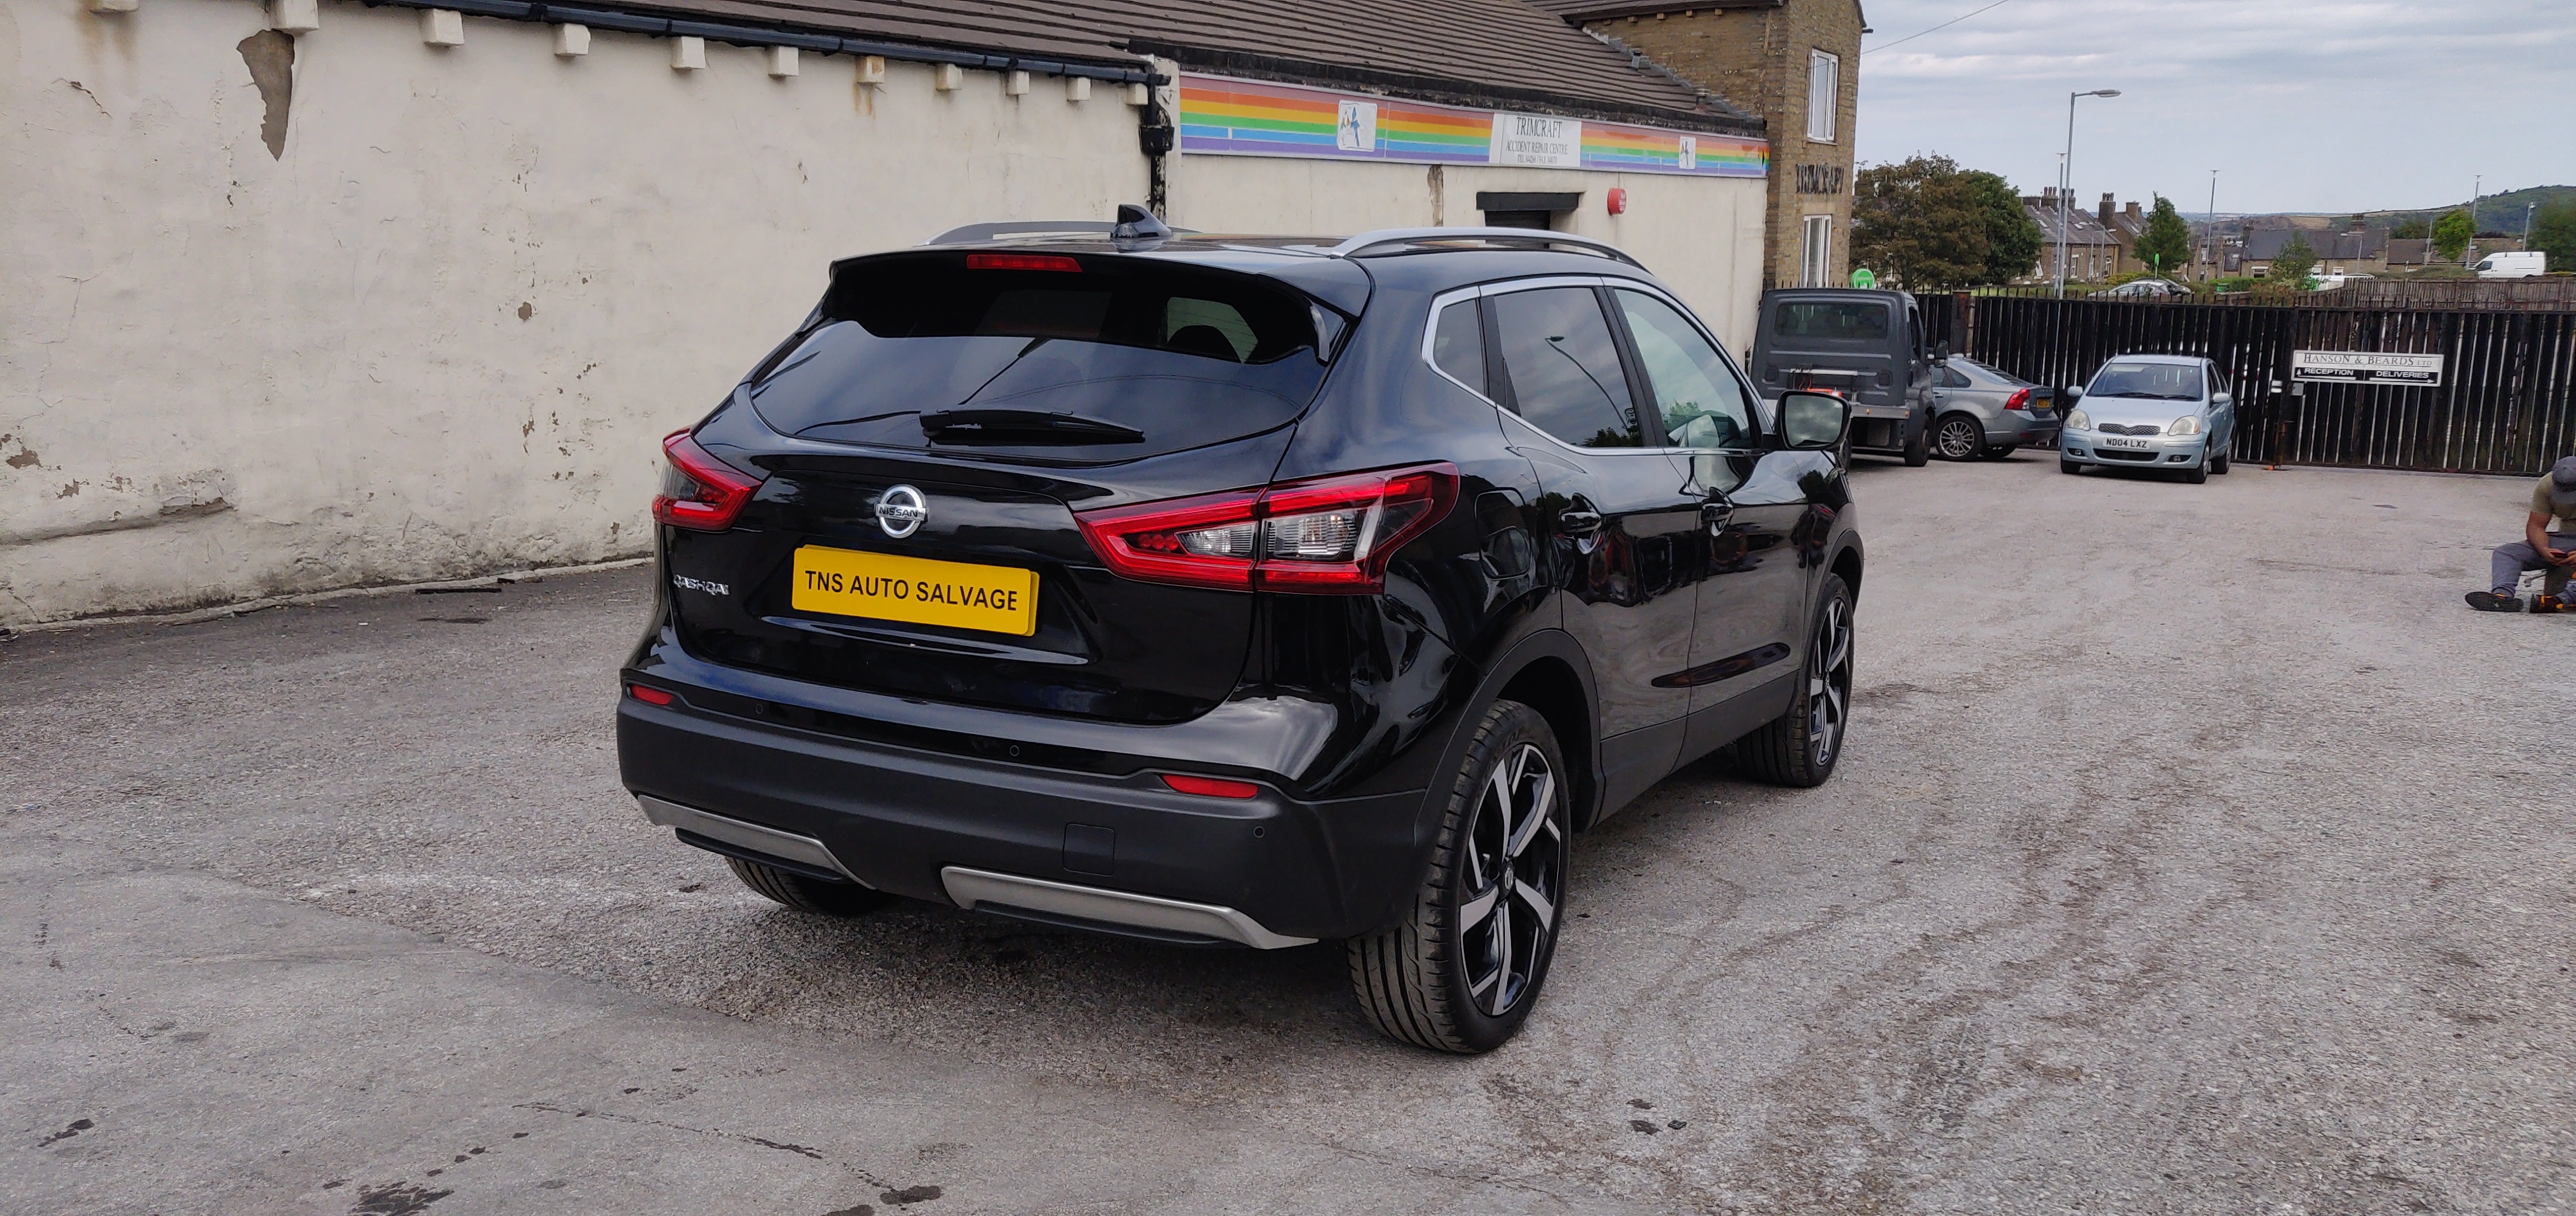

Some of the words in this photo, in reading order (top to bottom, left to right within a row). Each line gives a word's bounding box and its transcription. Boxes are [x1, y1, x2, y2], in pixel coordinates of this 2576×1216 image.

[1516, 117, 1562, 139] TRIMCRAFT
[1505, 139, 1531, 153] ACCIDENT
[1532, 142, 1549, 154] REPAIR
[1550, 143, 1568, 155] CENTRE
[2304, 354, 2350, 364] HANSON
[2355, 355, 2364, 364] &
[2367, 356, 2414, 365] BEARDS
[2304, 368, 2354, 376] RECEPTION
[2106, 438, 2128, 447] ND04
[2130, 439, 2147, 448] LXZ
[878, 506, 918, 517] NISSAN
[673, 574, 730, 596] QASHQAI
[804, 569, 843, 593] TNS
[849, 575, 910, 600] AUTO
[916, 581, 1018, 611] SALVAGE
